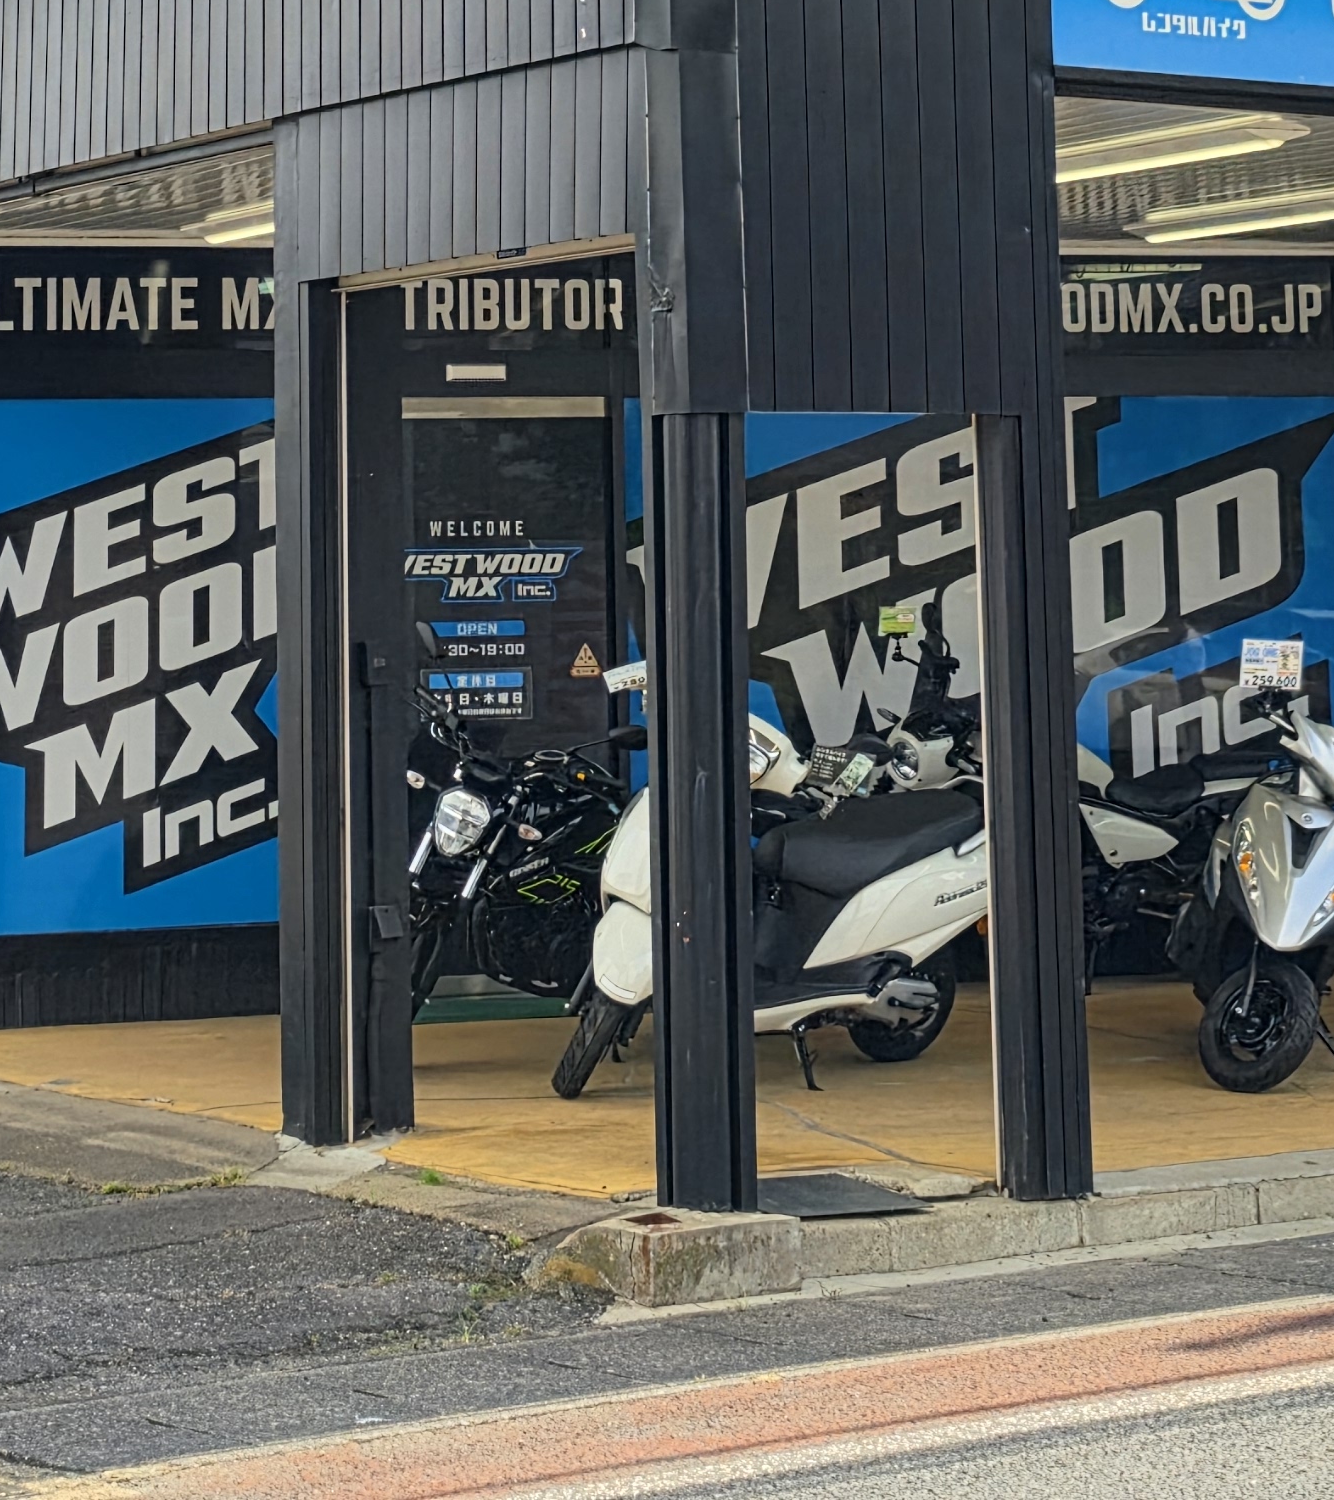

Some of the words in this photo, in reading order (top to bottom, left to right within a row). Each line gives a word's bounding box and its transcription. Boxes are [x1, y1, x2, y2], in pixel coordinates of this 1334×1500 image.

[221, 277, 275, 331] M
[429, 520, 524, 537] WELCOME
[448, 576, 504, 598] MX
[456, 622, 498, 636] OPEN
[23, 658, 263, 830] MX
